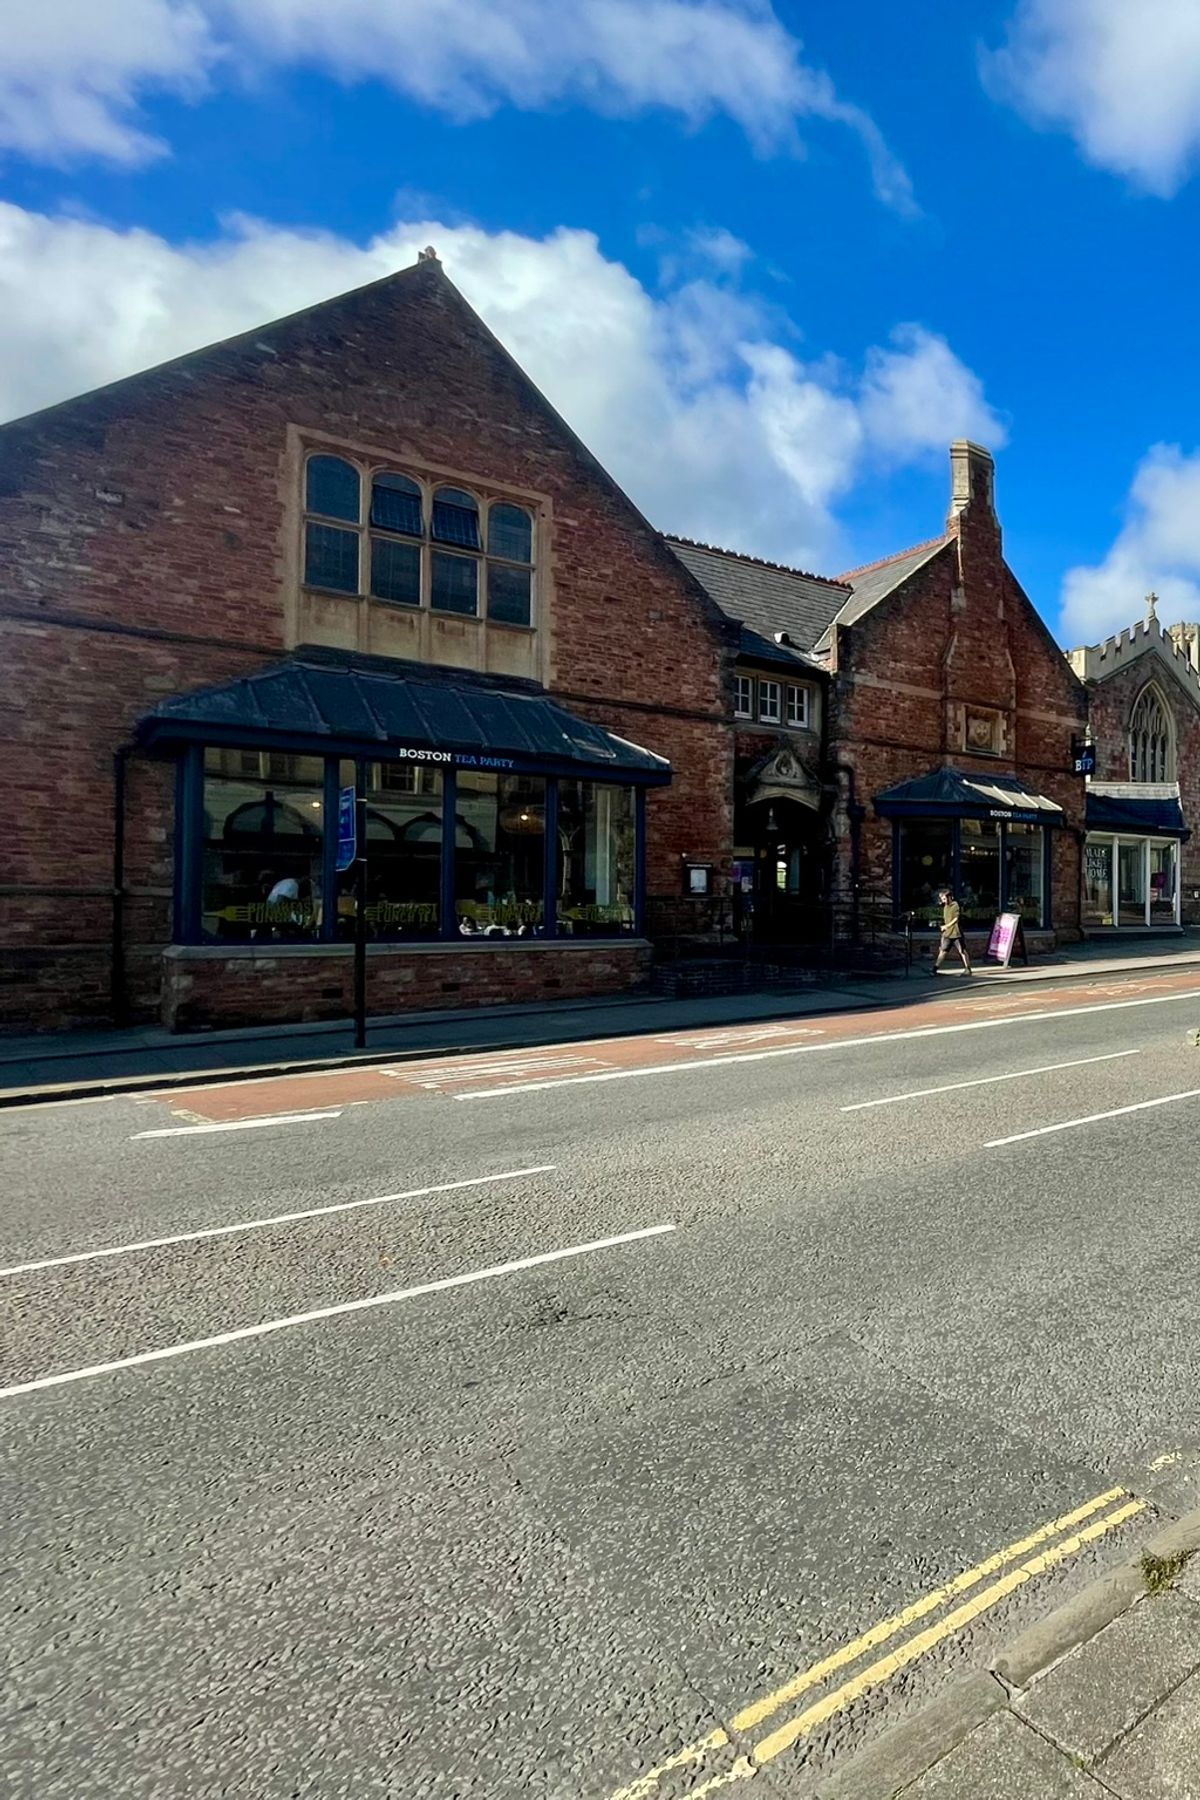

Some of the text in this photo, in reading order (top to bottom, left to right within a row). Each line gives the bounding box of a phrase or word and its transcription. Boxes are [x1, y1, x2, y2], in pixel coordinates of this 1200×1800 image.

[399, 748, 514, 768] BOSTON TEA PARTY
[1075, 758, 1093, 771] BTP
